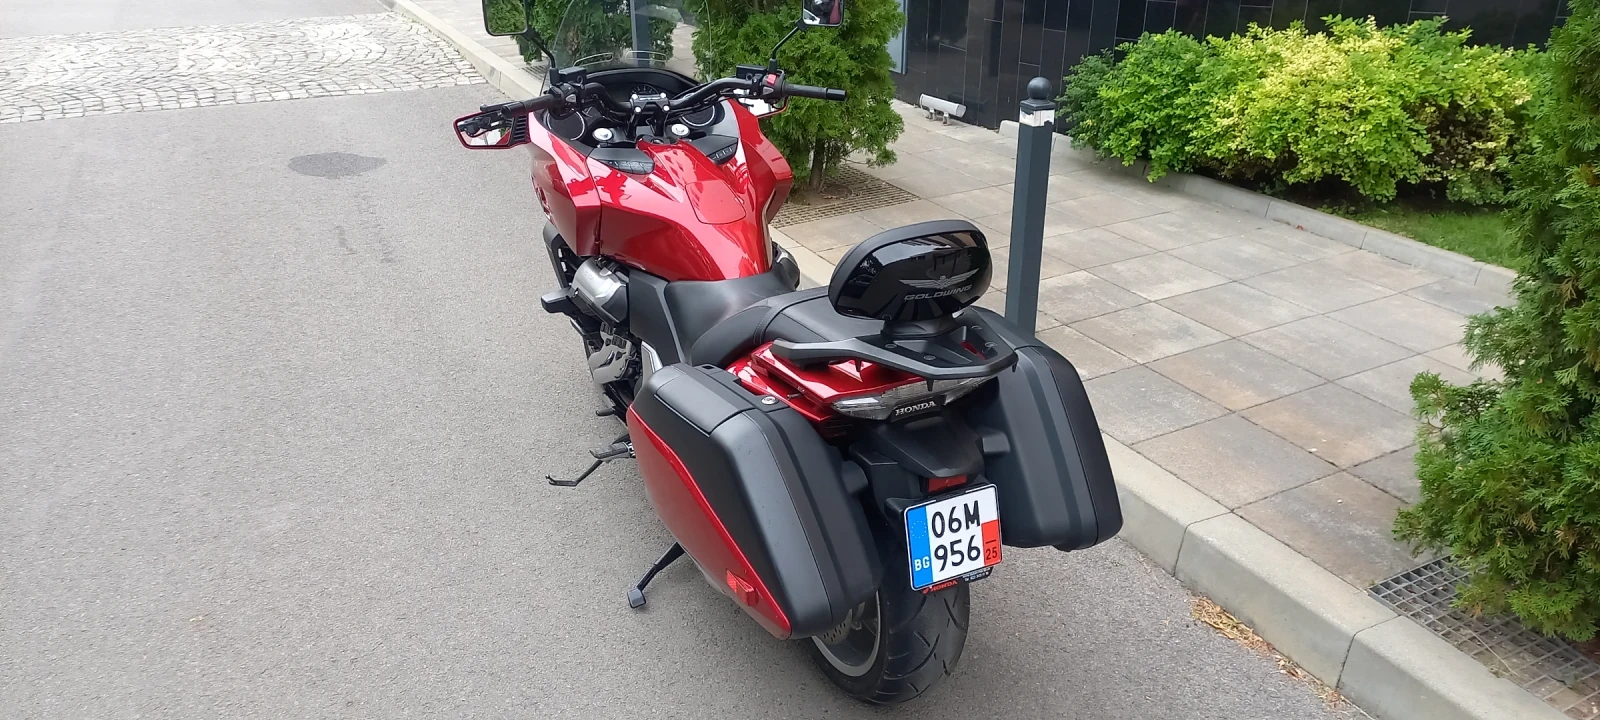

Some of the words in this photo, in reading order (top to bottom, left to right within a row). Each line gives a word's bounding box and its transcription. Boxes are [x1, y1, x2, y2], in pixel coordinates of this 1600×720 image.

[904, 284, 973, 301] GOLDWING
[895, 401, 937, 416] HONDA
[931, 500, 980, 538] 06M
[934, 534, 981, 572] 956
[985, 547, 998, 560] 25
[914, 556, 930, 571] BG
[930, 580, 958, 592] HONDA
